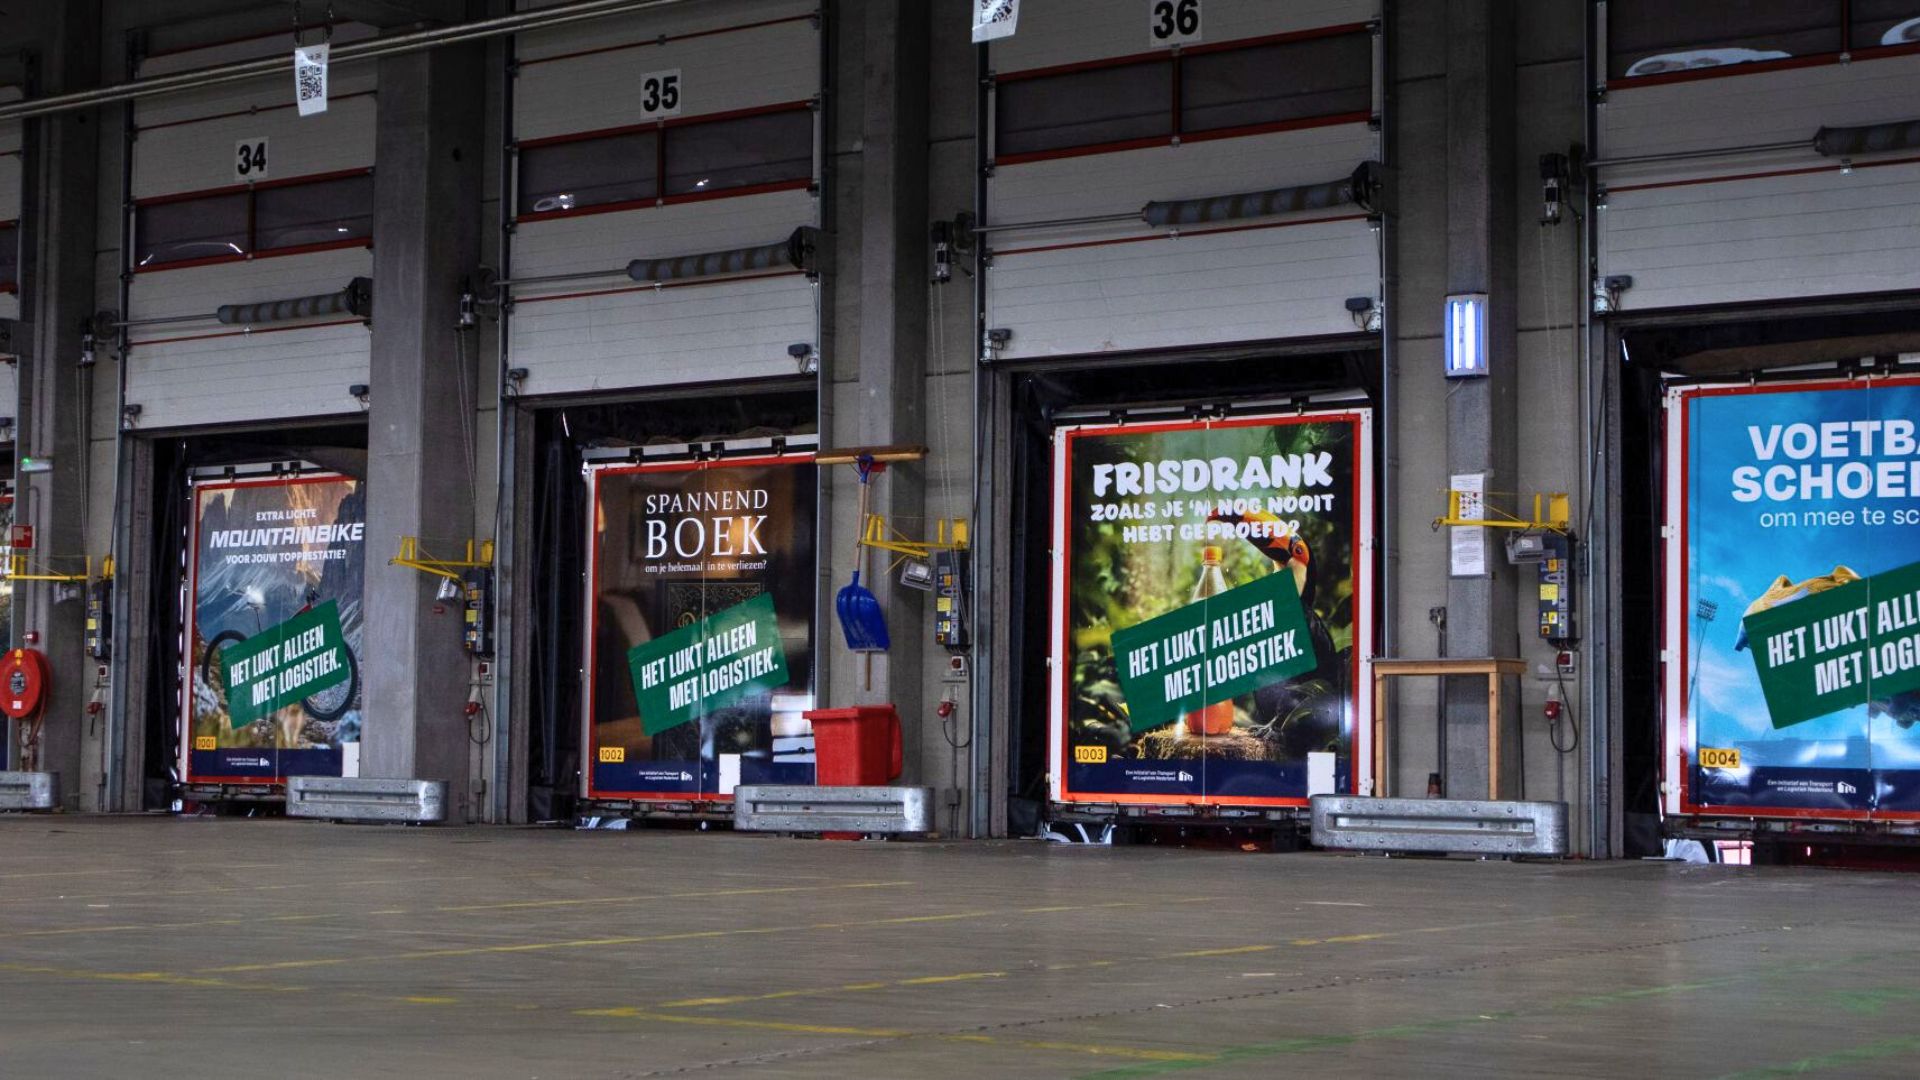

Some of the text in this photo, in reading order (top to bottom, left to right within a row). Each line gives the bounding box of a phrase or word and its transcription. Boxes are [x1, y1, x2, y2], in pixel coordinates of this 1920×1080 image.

[1152, 0, 1200, 39] 36
[643, 76, 678, 112] 35
[237, 143, 266, 175] 34
[1747, 419, 1920, 461] VOETB
[1092, 451, 1333, 498] FRISDRANK
[1732, 461, 1920, 503] SCHOE
[256, 509, 316, 521] EXTRA LICHTE
[646, 489, 768, 514] SPANNEND
[1090, 502, 1155, 521] ZOALS
[1161, 500, 1183, 517] JE
[1217, 498, 1261, 515] NOG
[1268, 494, 1335, 513] NOOIT
[1760, 511, 1796, 527] om
[1804, 509, 1854, 526] mee
[1862, 507, 1885, 525] te
[210, 523, 364, 548] MOUNTAINBIKE
[645, 515, 768, 558] BOEK
[1123, 520, 1300, 542] HEBT GEPROEFD?
[226, 549, 346, 564] VOOR JOUW TOPPRESTATIE?
[659, 563, 667, 575] je
[668, 560, 703, 572] helemaal
[707, 562, 715, 570] in
[717, 562, 726, 570] te
[728, 560, 767, 570] verliezen?
[230, 624, 324, 687] HET LUKT ALLEEN
[641, 620, 757, 690] HET LUKT ALLEEN
[1128, 600, 1274, 678] HET LUKT ALLEEN
[1767, 627, 1807, 668] HET
[1813, 606, 1868, 654] LUKT
[252, 647, 342, 706] MET LOGISTIEK.
[669, 646, 778, 711] MET LOGISTIEK.
[1164, 629, 1303, 703] MET LOGISTIEK.
[1814, 652, 1863, 696] MET
[600, 748, 622, 761] 1002
[1076, 748, 1104, 761] 1003
[1702, 751, 1737, 766] 1004
